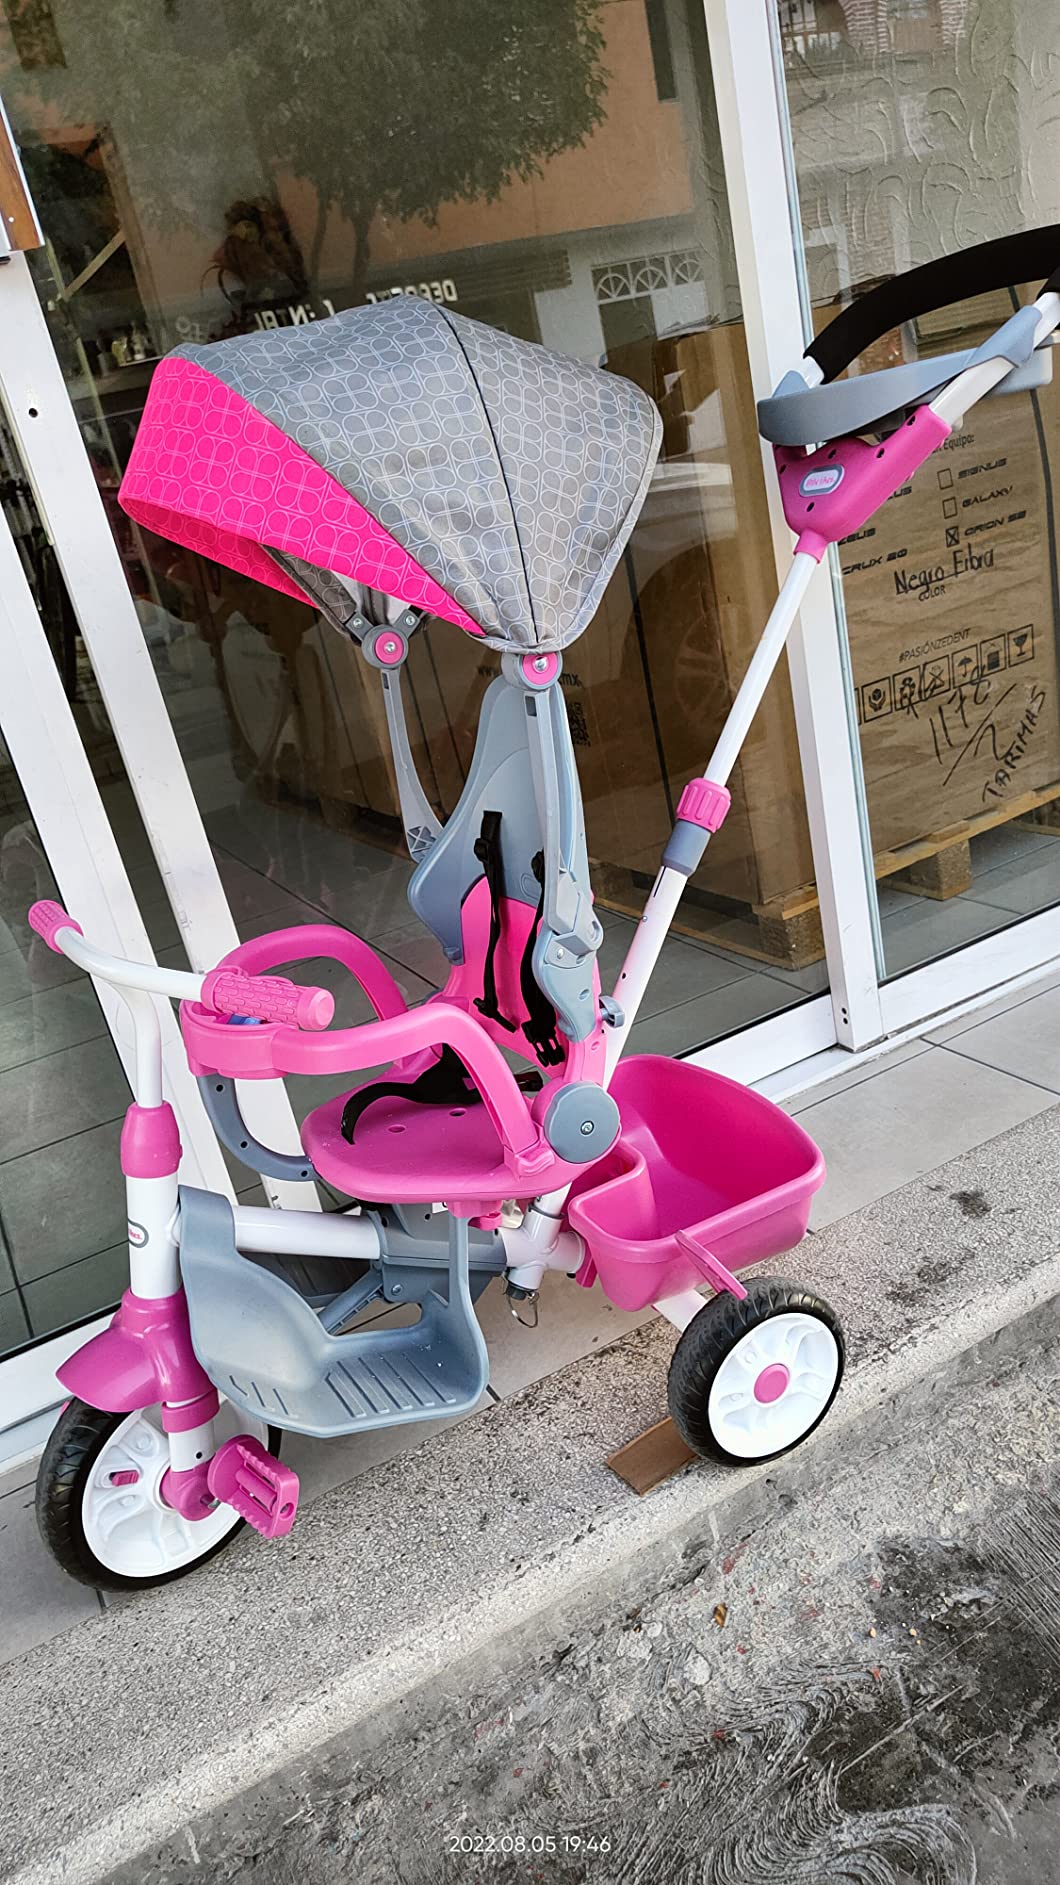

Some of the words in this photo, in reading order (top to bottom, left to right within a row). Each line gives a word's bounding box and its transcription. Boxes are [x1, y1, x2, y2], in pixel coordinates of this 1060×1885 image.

[961, 485, 1013, 508] GALAXY
[964, 516, 1005, 536] ORION
[841, 555, 883, 576] CRUX
[894, 566, 945, 596] Negro
[981, 685, 1046, 803] TARIMAS
